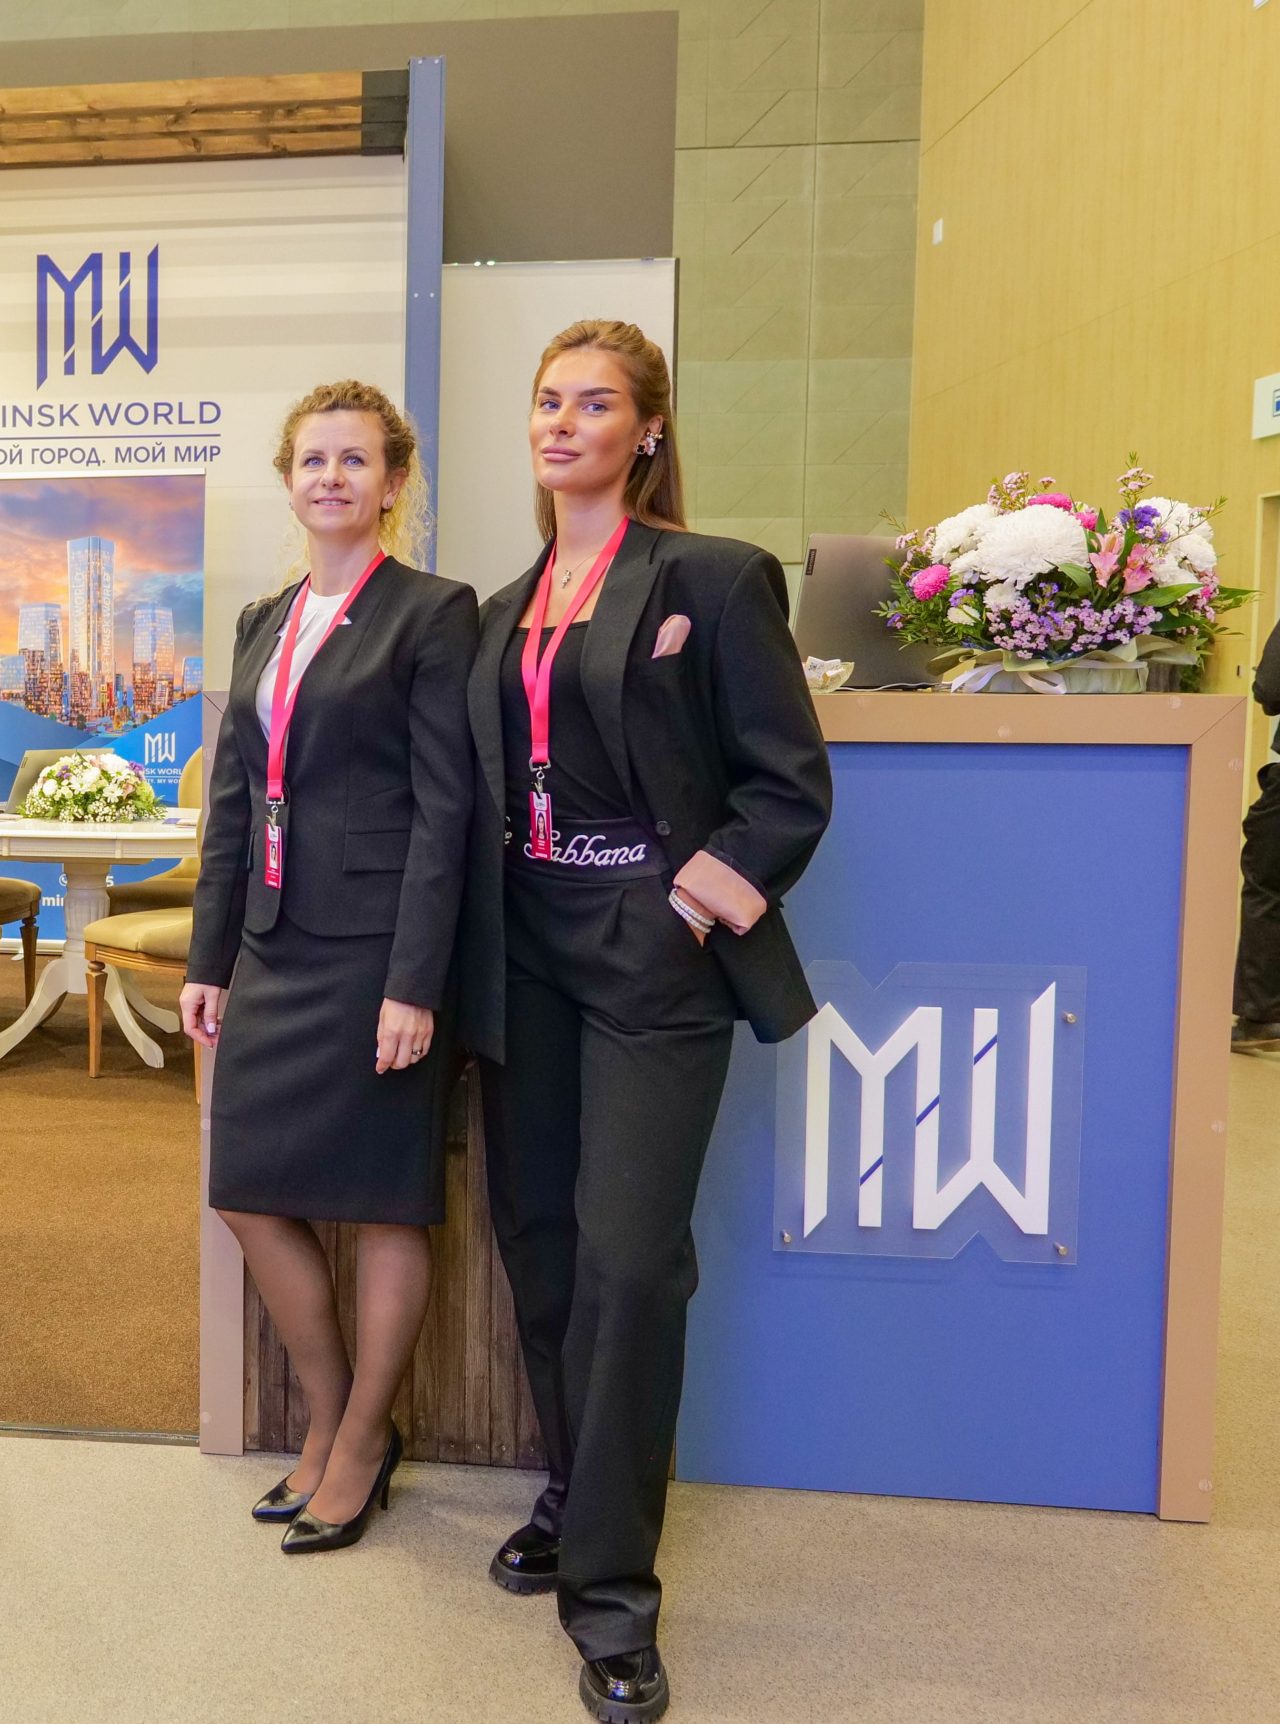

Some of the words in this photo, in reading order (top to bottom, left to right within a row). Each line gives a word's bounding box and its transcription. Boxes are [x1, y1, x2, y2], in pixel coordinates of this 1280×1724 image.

[88, 401, 221, 426] WORLD
[31, 447, 106, 467] ГОРОД.
[115, 442, 165, 463] МОЙ
[174, 446, 221, 463] МИР
[102, 572, 111, 617] WORLD
[157, 767, 183, 775] WORL
